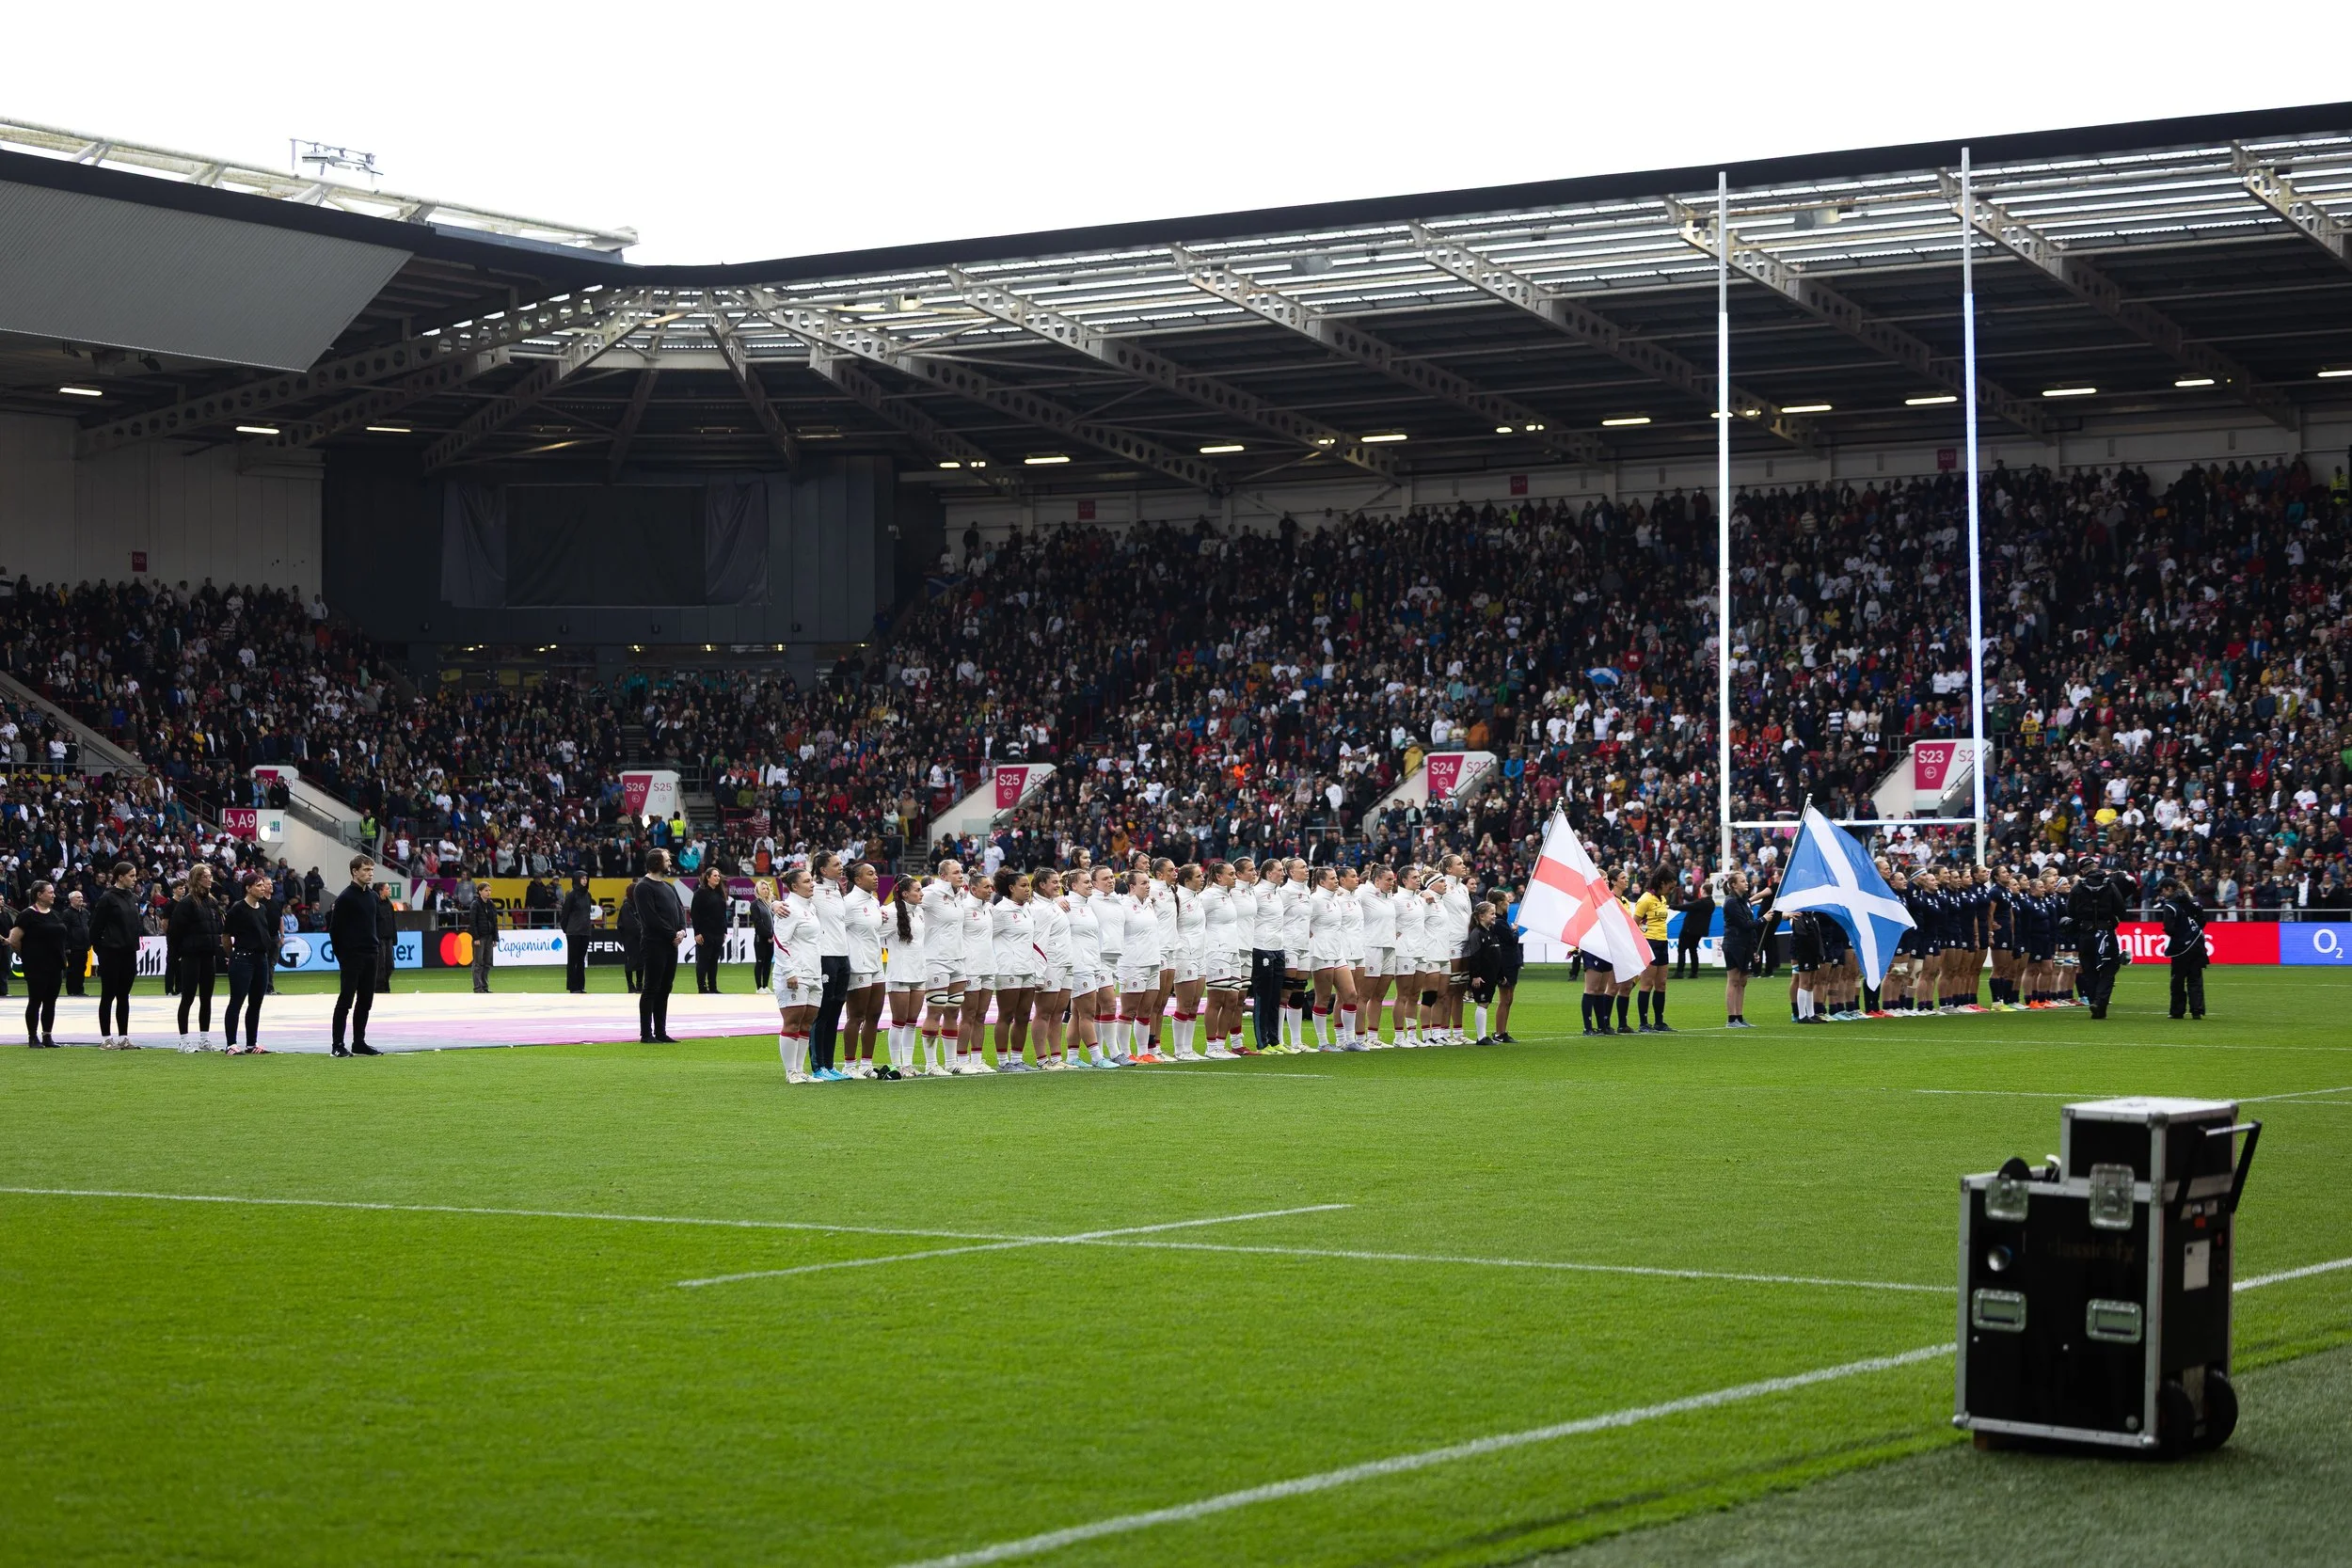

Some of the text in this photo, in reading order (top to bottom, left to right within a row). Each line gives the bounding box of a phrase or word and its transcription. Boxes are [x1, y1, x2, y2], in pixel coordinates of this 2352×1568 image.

[1918, 750, 1945, 764] S23
[1959, 750, 1975, 762] S2
[1431, 762, 1455, 775] S24
[999, 774, 1021, 786] S25
[1030, 773, 1047, 784] S2
[626, 783, 645, 792] S26
[653, 783, 673, 792] S25
[238, 813, 256, 828] A9
[497, 938, 550, 958] Capgemini
[587, 942, 626, 953] EFEN
[2312, 928, 2344, 958] O2
